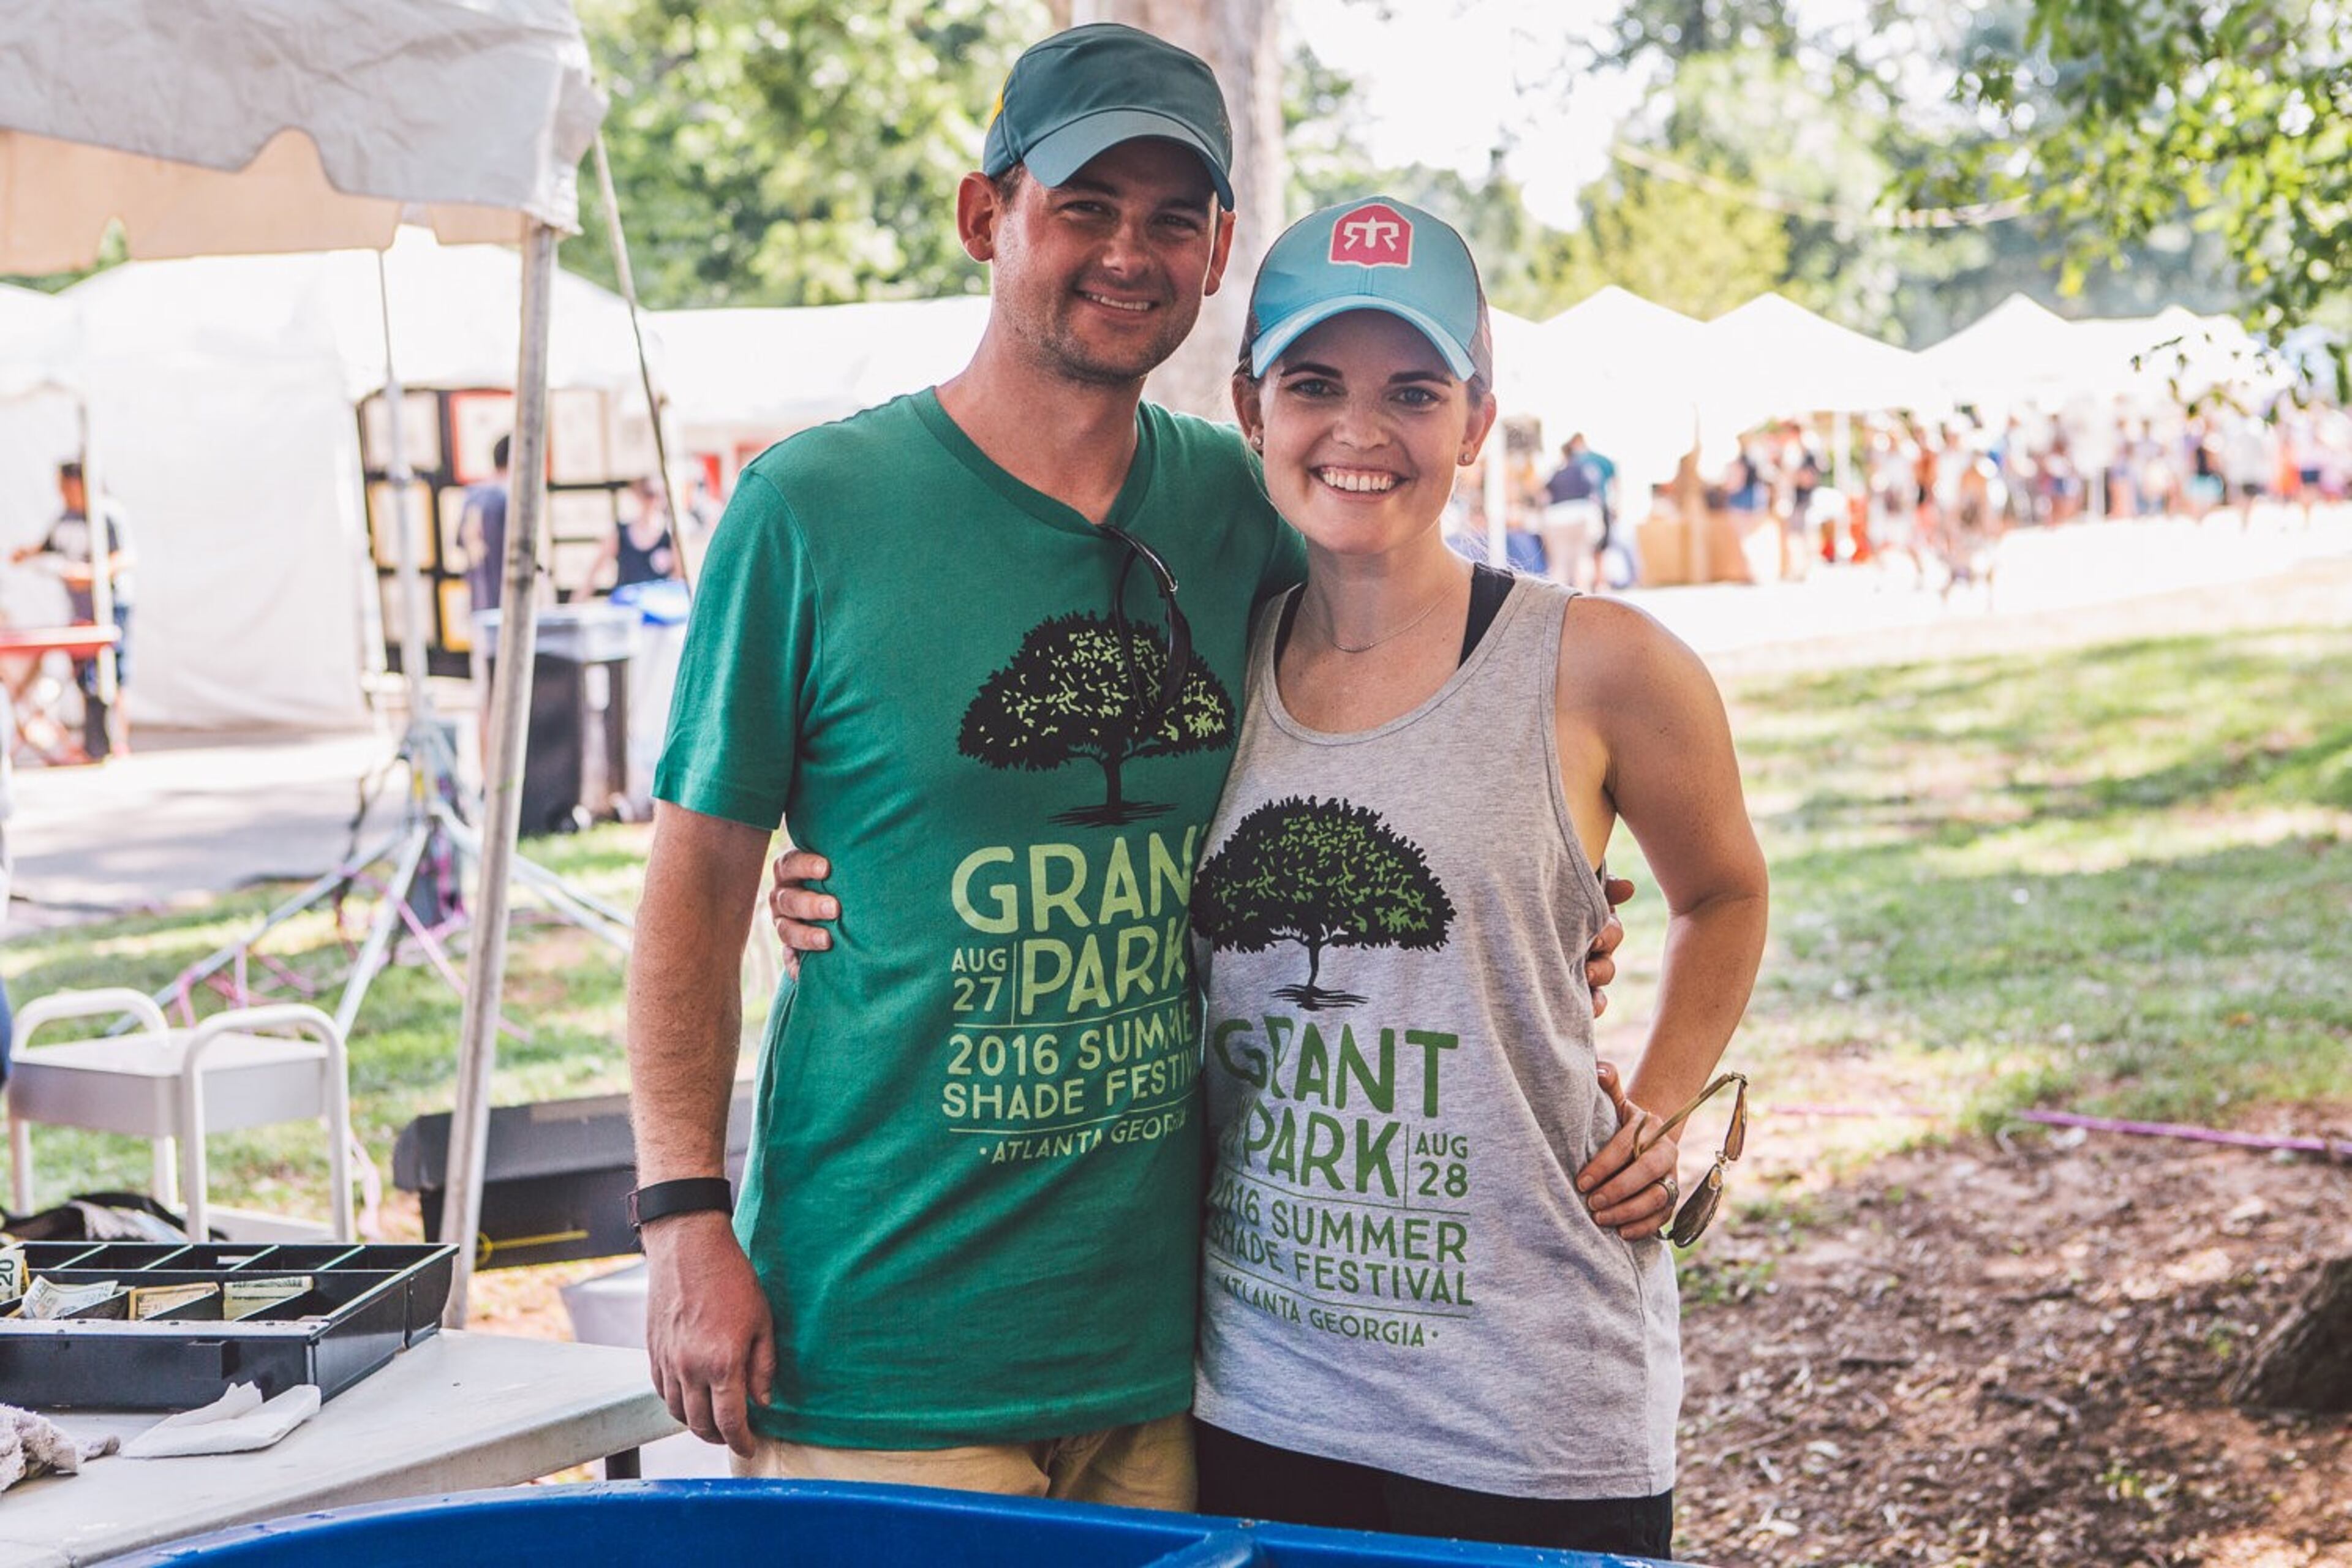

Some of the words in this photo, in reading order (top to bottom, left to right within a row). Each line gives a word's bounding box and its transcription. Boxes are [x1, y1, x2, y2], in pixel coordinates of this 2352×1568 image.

[951, 824, 1208, 933] GRAN
[951, 948, 1006, 973] AUG
[1021, 913, 1189, 1015] PARK
[952, 978, 1003, 1011] 27
[948, 1033, 1060, 1076] 2016
[1078, 1001, 1193, 1071] SUMME
[1214, 1016, 1459, 1118] GRANT
[942, 1079, 1084, 1120] SHADE
[1106, 1046, 1196, 1106] FESTIV
[1243, 1098, 1401, 1197] PARK
[1415, 1131, 1468, 1159] AUG
[1418, 1162, 1468, 1197] 28
[1272, 1199, 1468, 1264] SUMMER
[1294, 1251, 1473, 1306] FESTIVAL
[1310, 1308, 1425, 1348] GEORGIA
